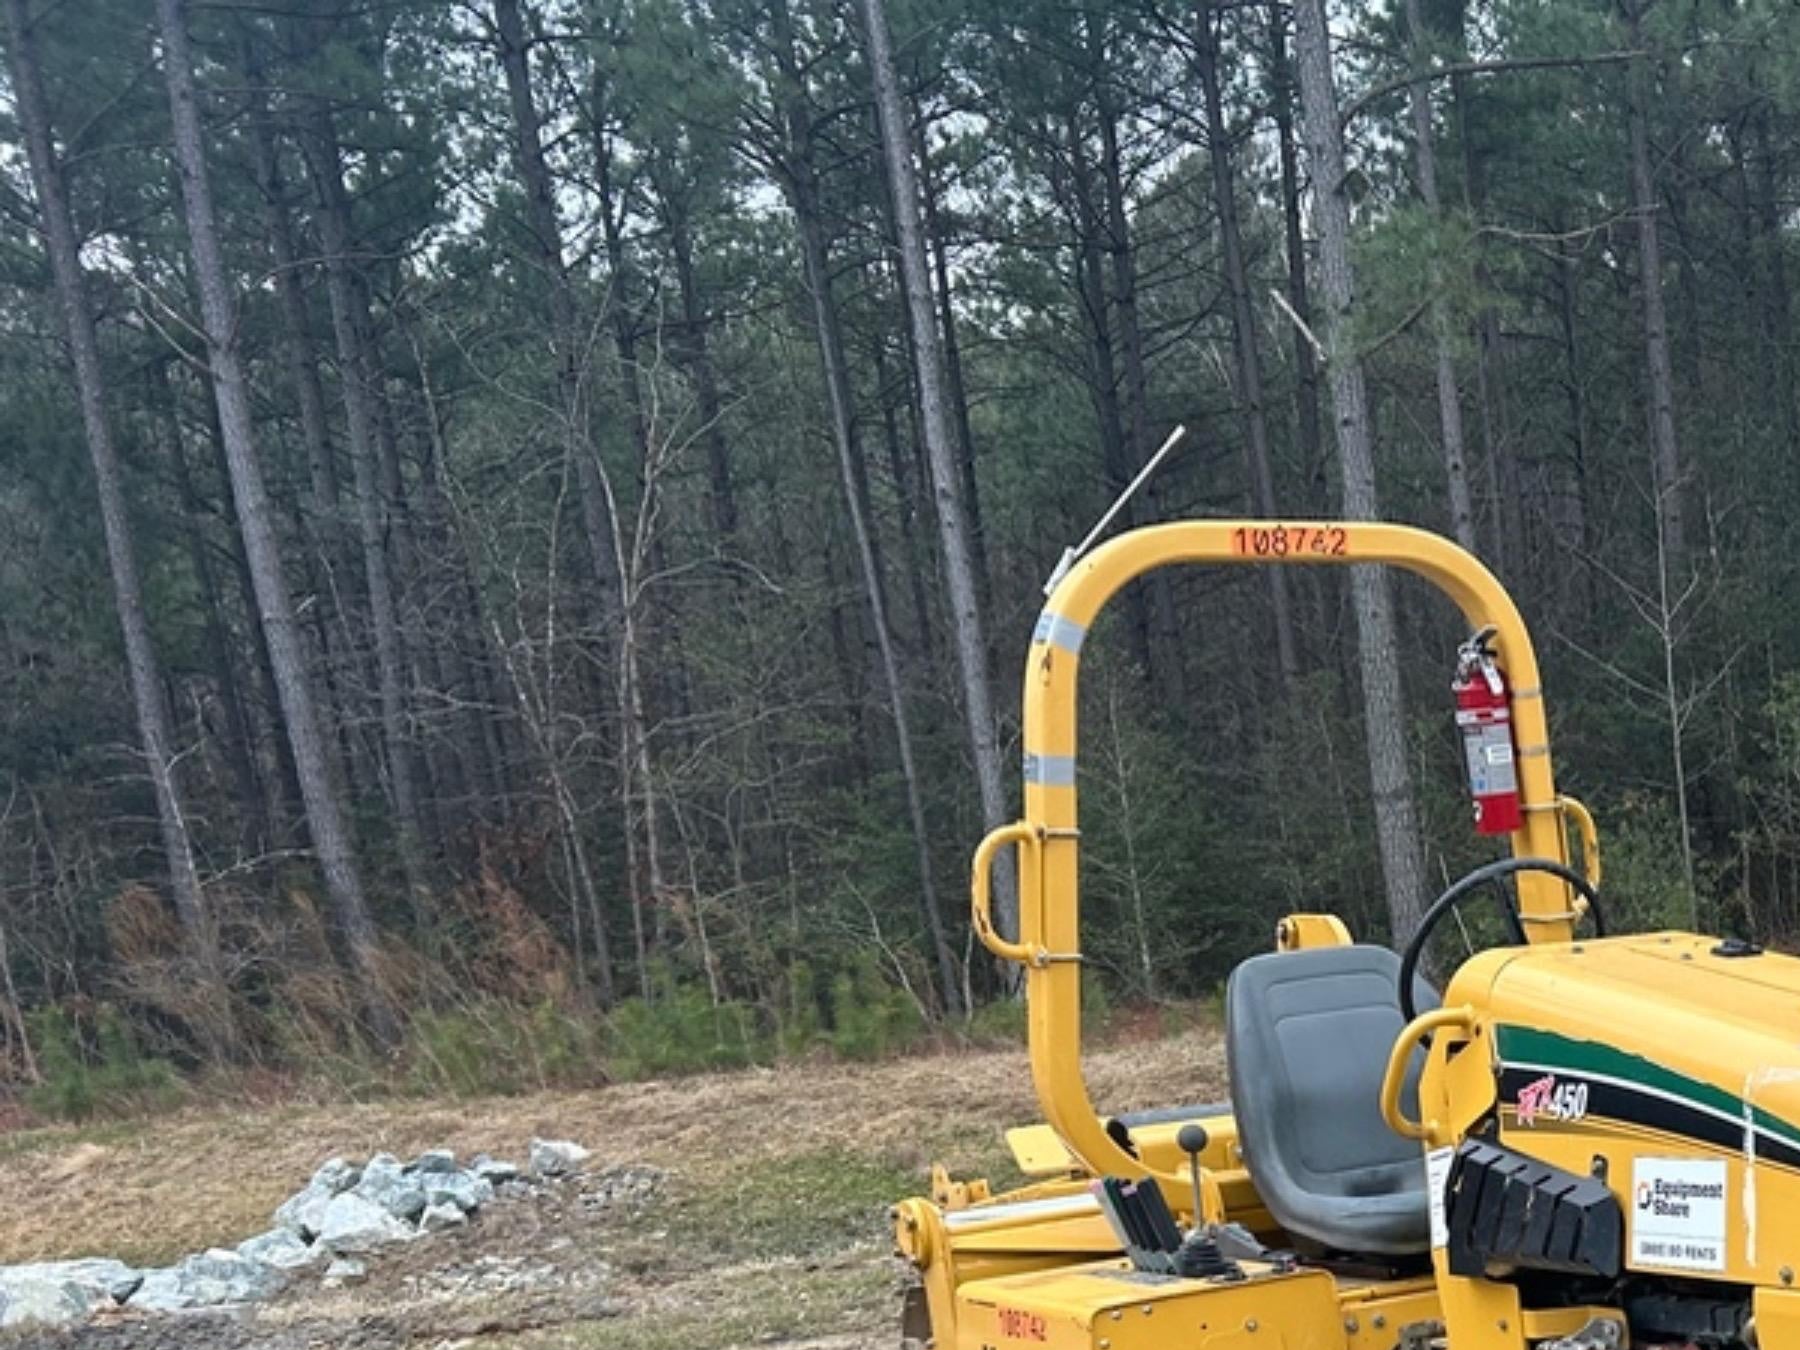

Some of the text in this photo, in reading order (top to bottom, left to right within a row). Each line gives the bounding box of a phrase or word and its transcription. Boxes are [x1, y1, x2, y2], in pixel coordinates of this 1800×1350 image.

[1234, 526, 1348, 556] 108742
[1653, 1178, 1723, 1200] Equipment
[1653, 1198, 1690, 1218] Share
